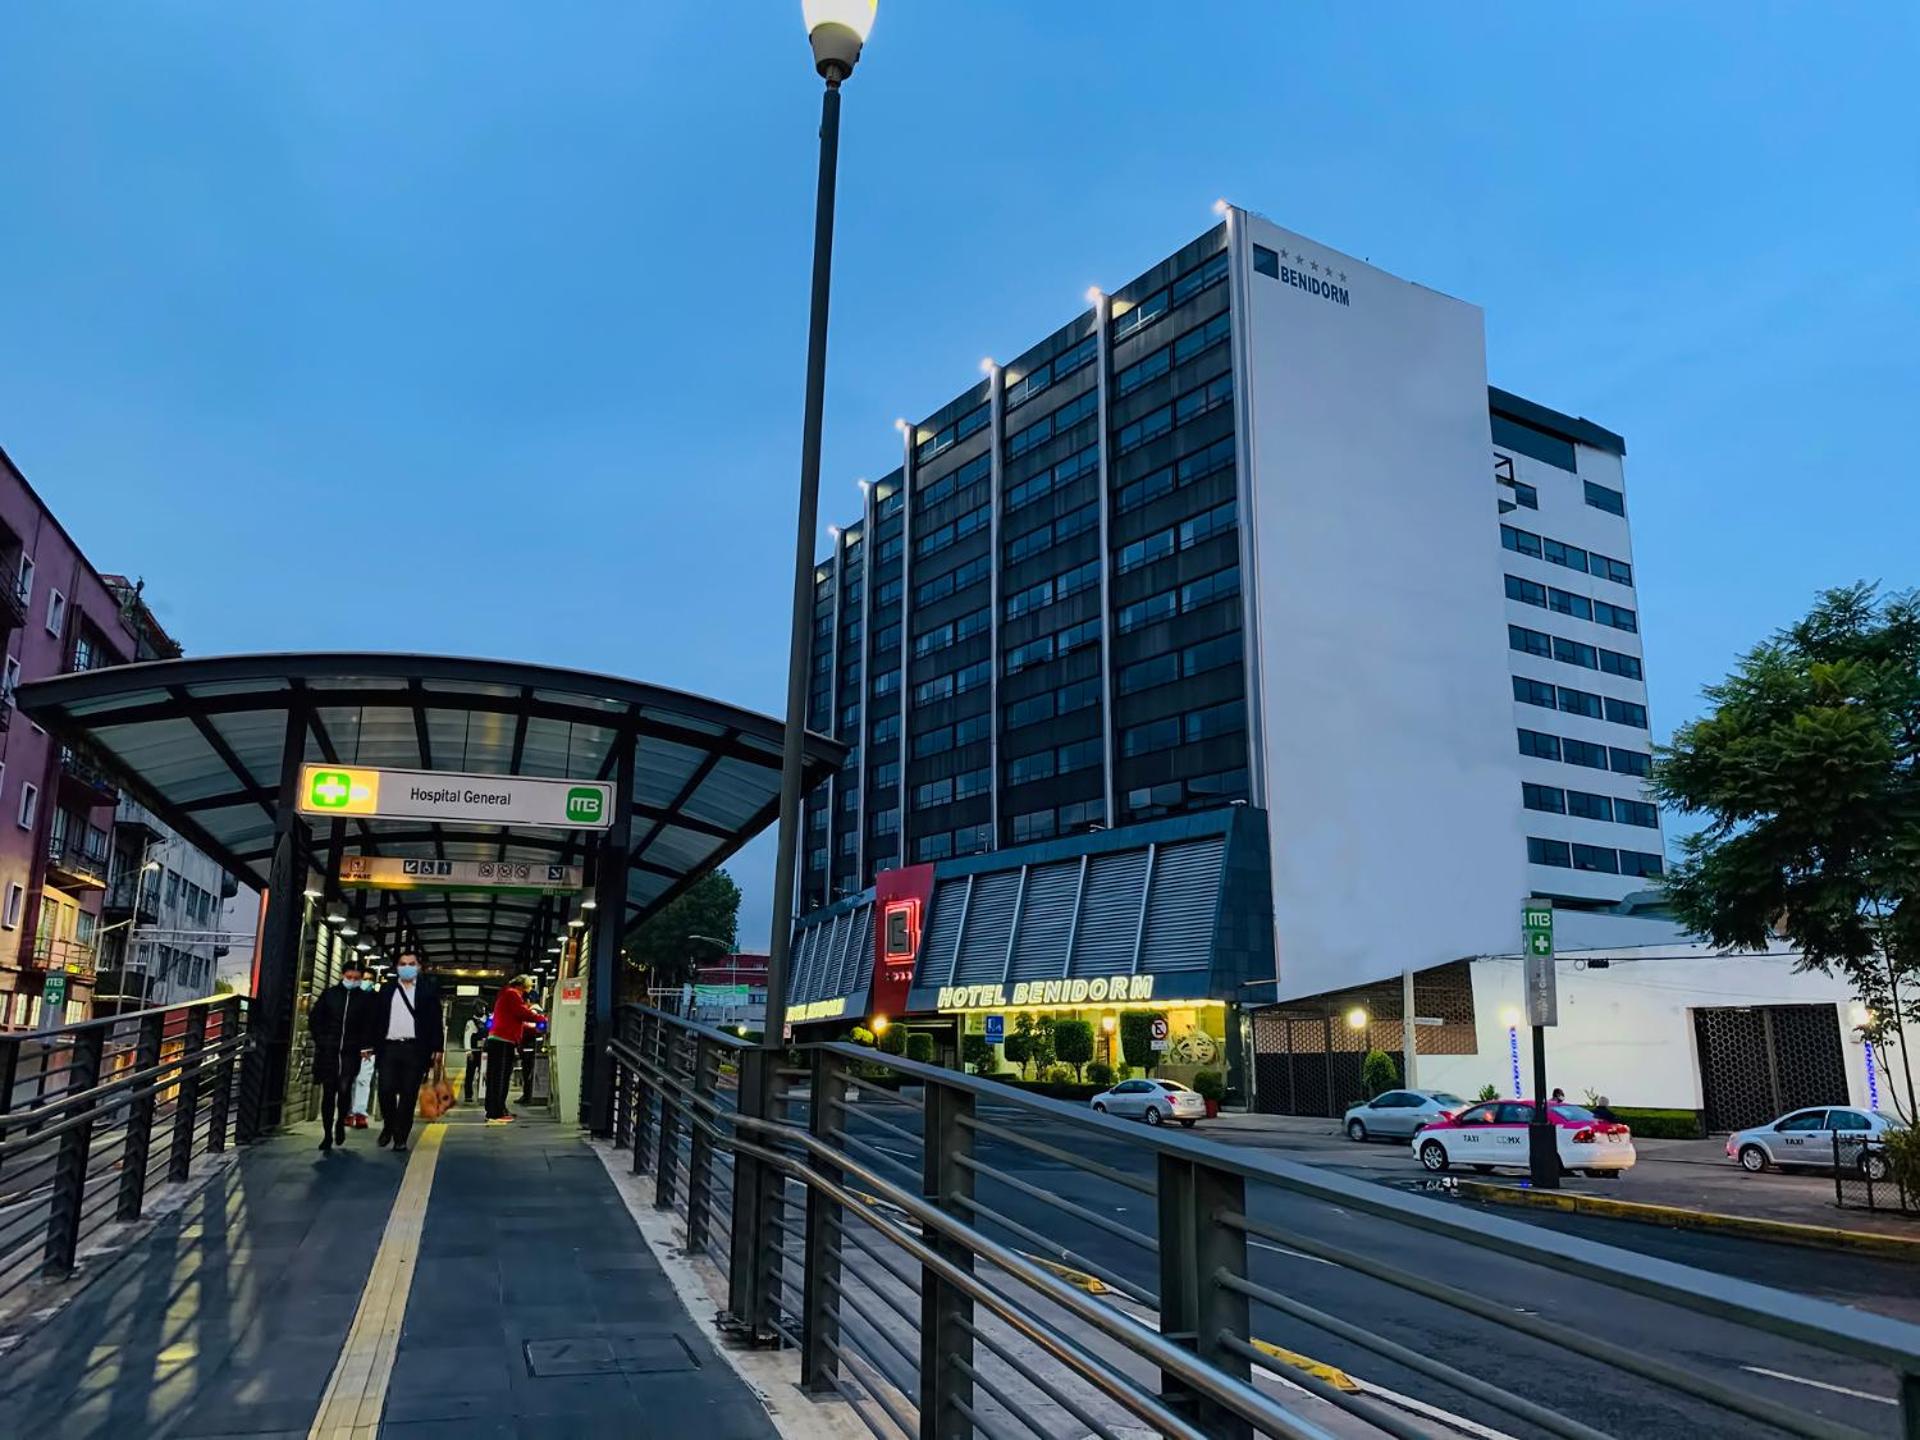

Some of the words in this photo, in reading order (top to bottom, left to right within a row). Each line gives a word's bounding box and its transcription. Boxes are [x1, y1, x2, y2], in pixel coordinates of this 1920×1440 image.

[1281, 266, 1350, 306] BENIDORM
[410, 787, 461, 804] Hospital
[464, 790, 512, 805] General
[937, 984, 1007, 1008] HOTEL
[1012, 975, 1154, 1005] BENIDORM
[1463, 1134, 1480, 1143] TAXI
